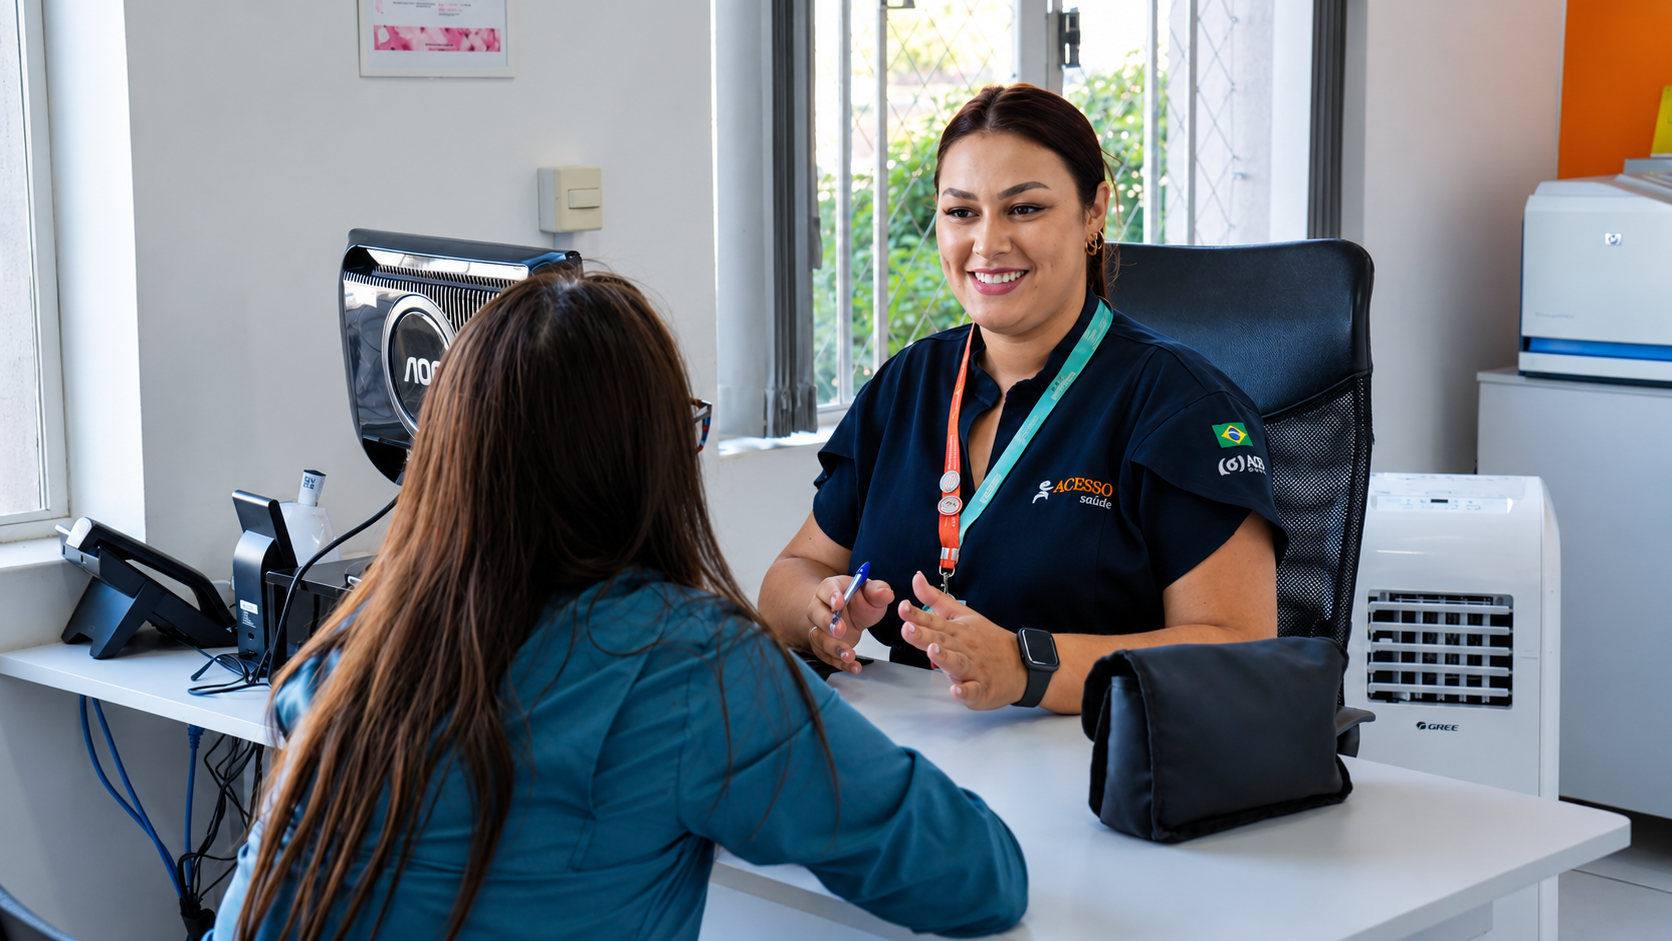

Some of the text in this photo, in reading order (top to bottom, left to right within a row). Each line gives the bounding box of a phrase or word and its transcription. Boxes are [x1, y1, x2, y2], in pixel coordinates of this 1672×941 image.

[1052, 477, 1113, 497] ACESSO
[1079, 494, 1112, 509] saúde
[1428, 723, 1459, 732] GREE
